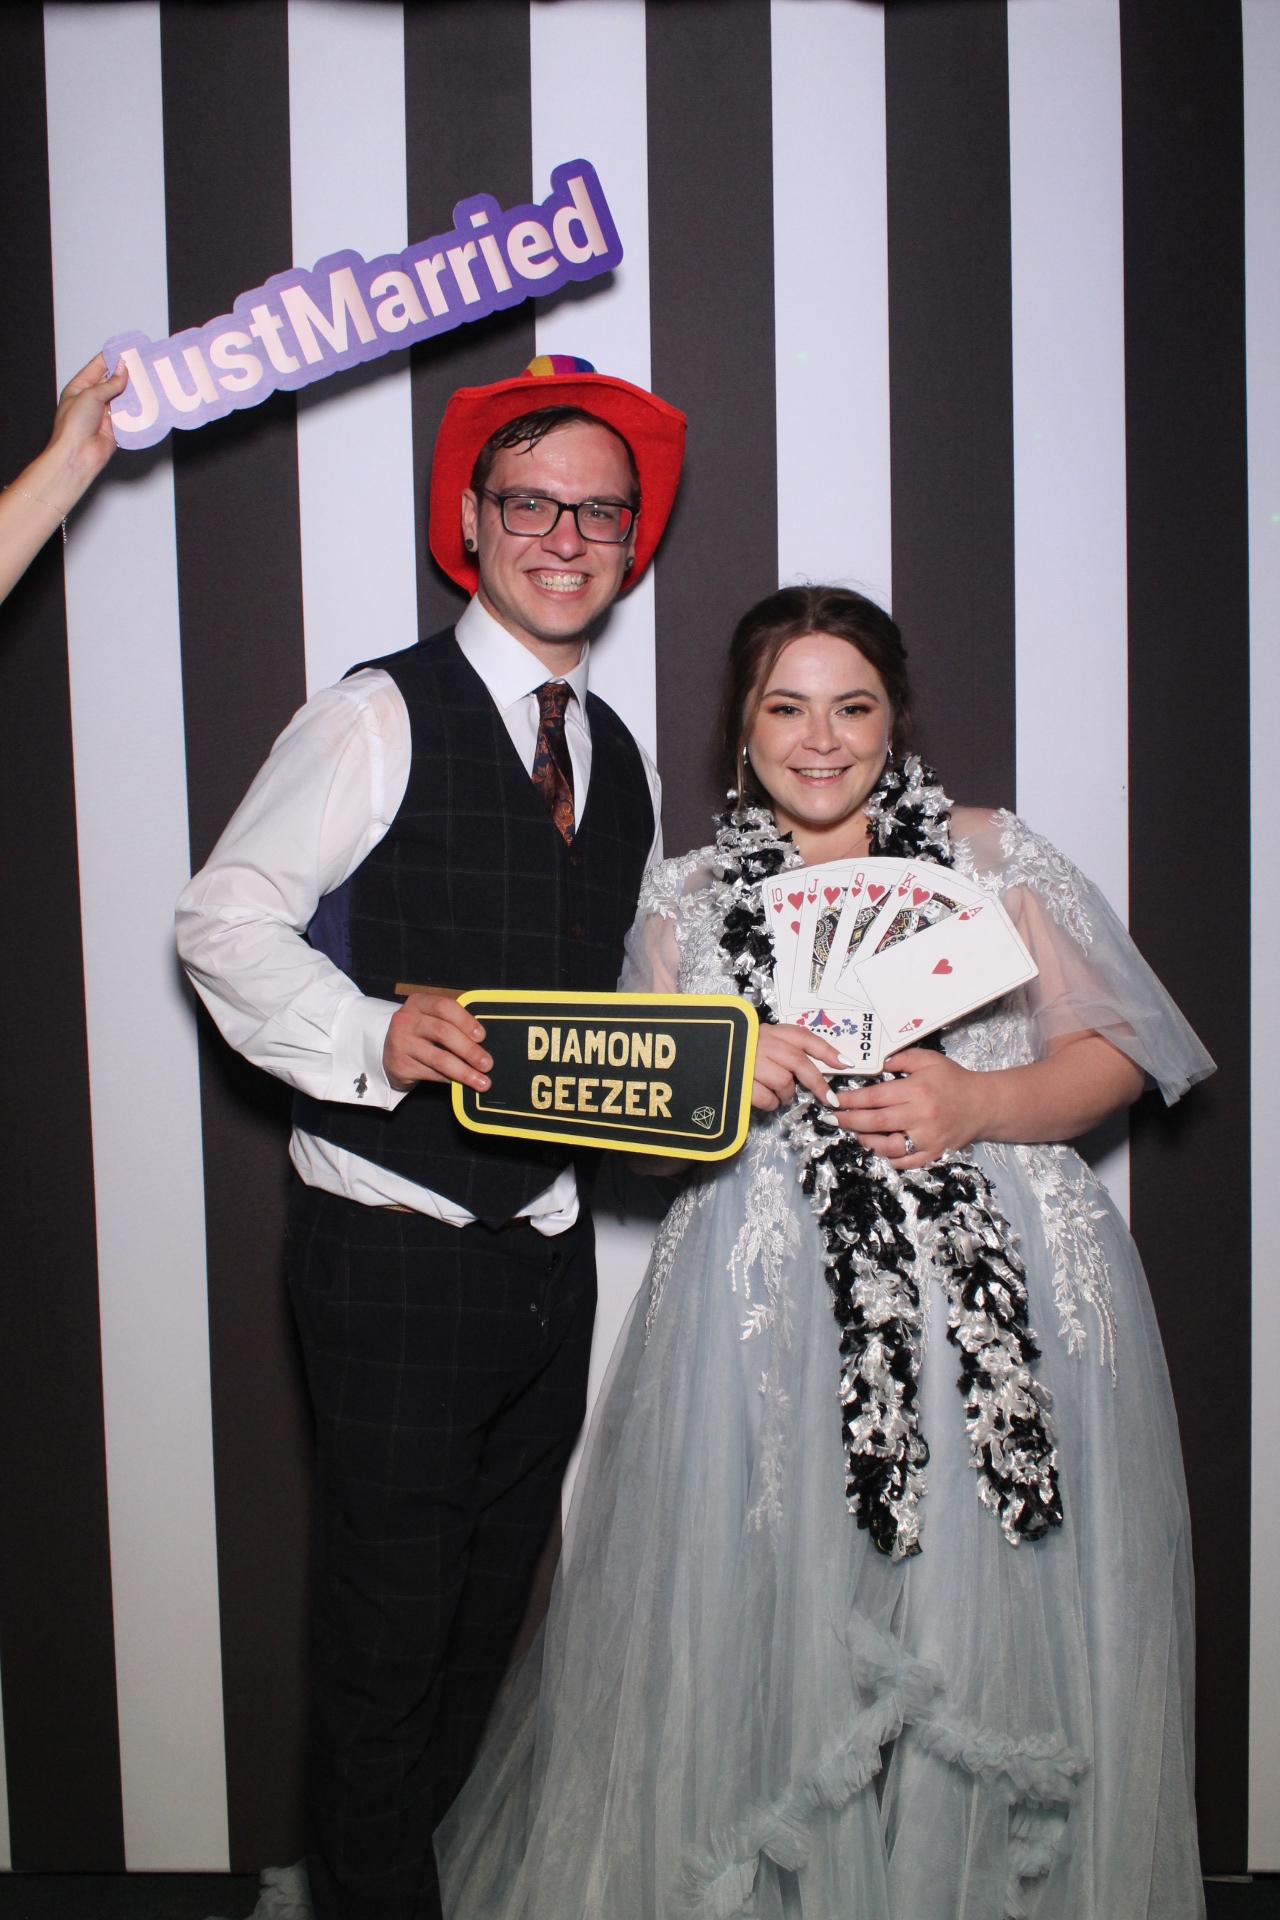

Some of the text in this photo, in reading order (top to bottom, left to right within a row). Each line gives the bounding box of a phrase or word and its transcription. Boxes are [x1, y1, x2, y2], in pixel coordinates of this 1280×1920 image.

[808, 878, 819, 893] J
[854, 872, 865, 888] Q
[901, 872, 917, 888] K
[771, 888, 783, 902] 10
[968, 906, 983, 918] A
[860, 1013, 874, 1060] JOKER
[527, 1025, 677, 1069] DIAMOND
[531, 1074, 673, 1118] GEEZER
